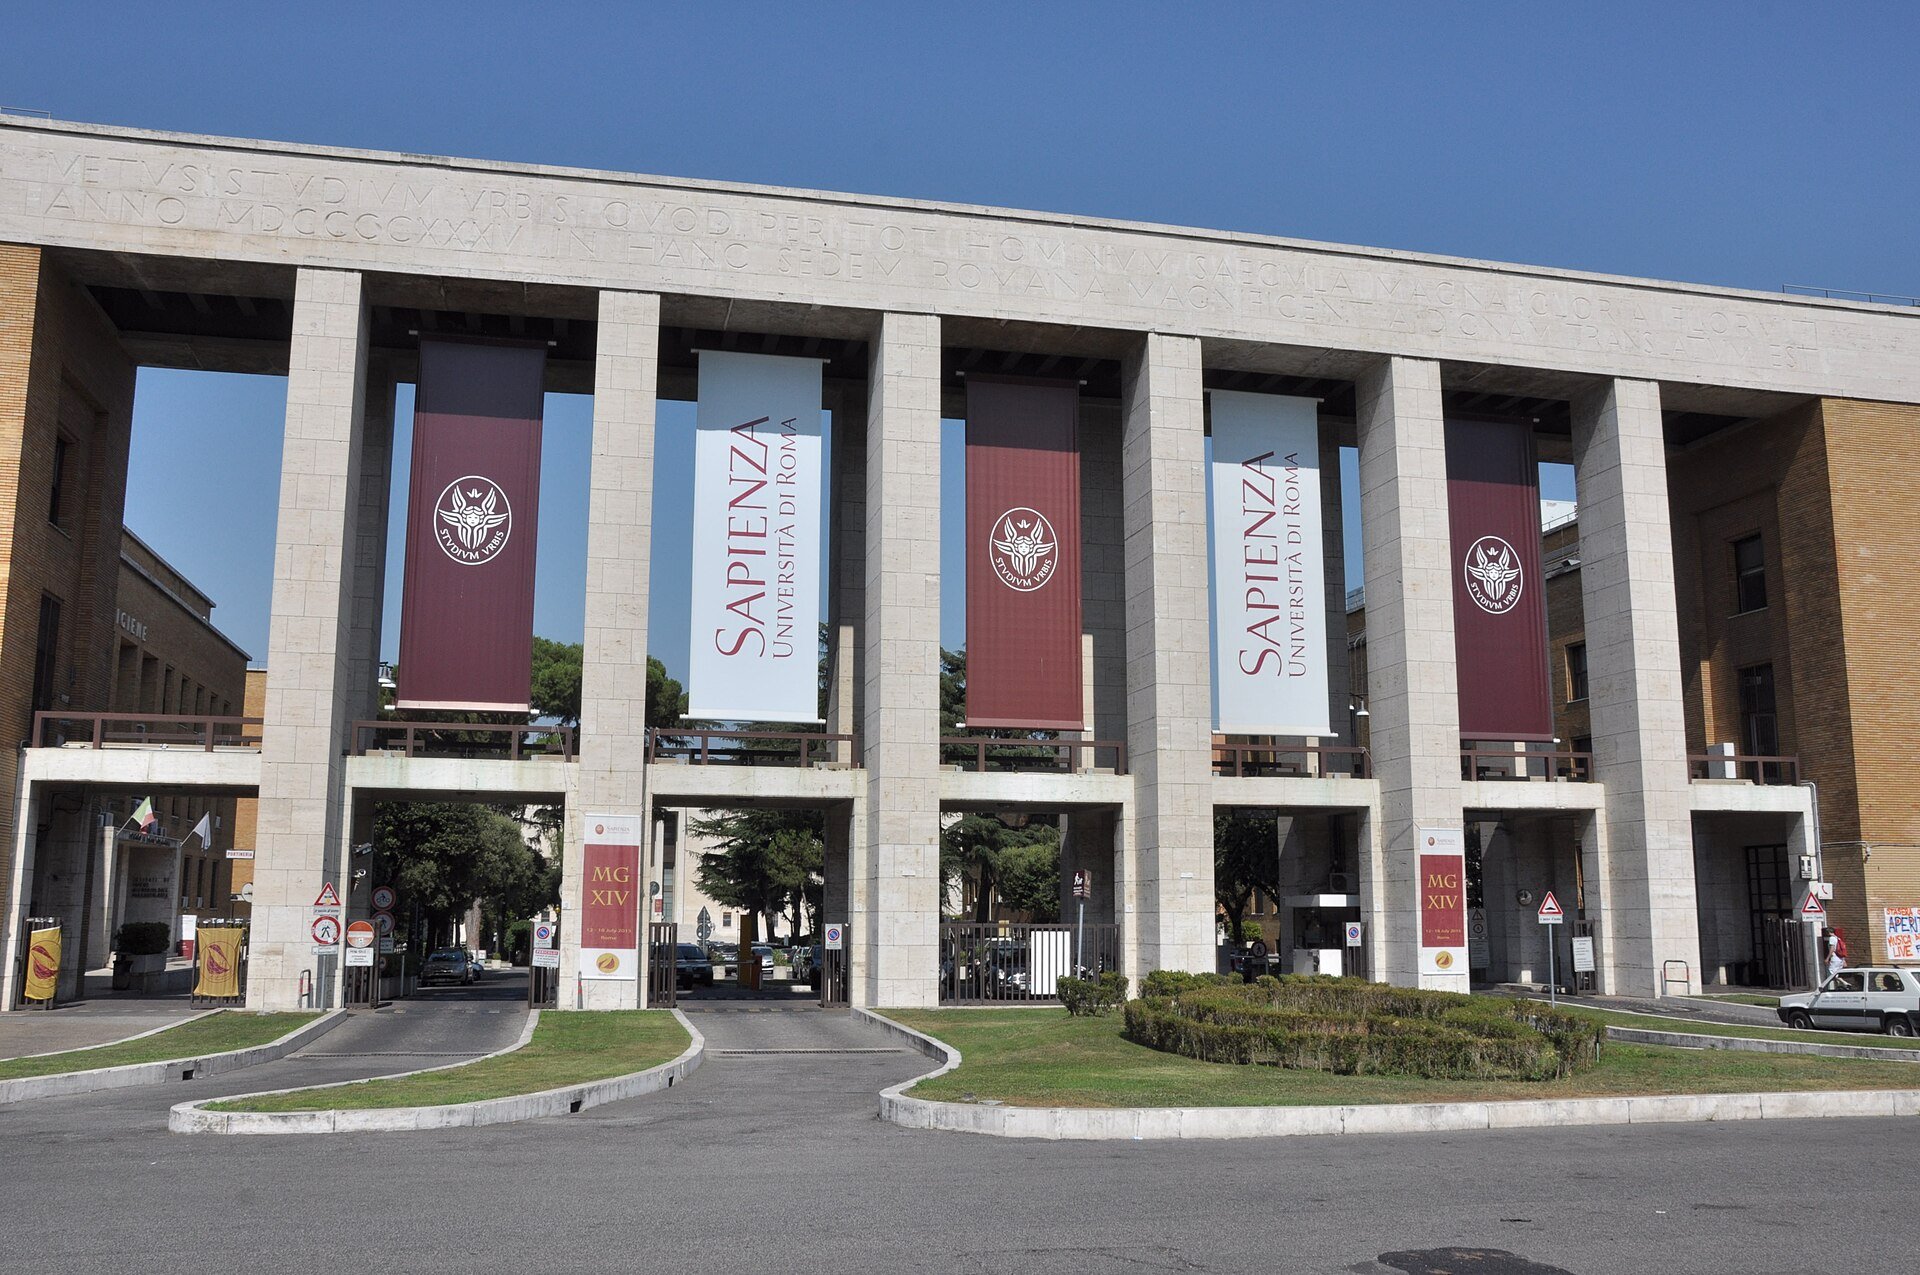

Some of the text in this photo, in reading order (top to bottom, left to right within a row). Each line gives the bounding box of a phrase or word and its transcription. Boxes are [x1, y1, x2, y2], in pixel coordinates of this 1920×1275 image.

[46, 151, 198, 193] VETVS
[224, 168, 434, 212] STVDIVM
[459, 187, 569, 224] VRBIS
[602, 200, 732, 236] QVOD
[760, 212, 826, 245] PER
[44, 188, 186, 224] ANNO
[215, 201, 523, 248] MDCCCCXXXV
[556, 228, 598, 260] IN
[628, 233, 749, 269] HANC
[778, 246, 903, 283] SEDEM
[933, 260, 1105, 298] ROMANA
[440, 528, 504, 560] STVDIVM VRBIS
[715, 416, 770, 657] SAPIENZA
[773, 417, 797, 659] UNIVERSITÀ DI ROMA
[995, 557, 1053, 587] STVDIVM VRBIS
[1238, 450, 1283, 677] SAPIENZA
[1283, 452, 1307, 678] UNIVERSITÀ DI ROMA
[1470, 582, 1519, 610] STVDIVM VRBIS
[116, 608, 147, 641] IGIENE
[591, 865, 630, 883] MG
[1427, 874, 1457, 889] MG
[591, 889, 630, 906] XIV
[1427, 895, 1458, 909] XIV
[1888, 935, 1912, 947] MUSICA
[1893, 945, 1913, 957] LIVE
